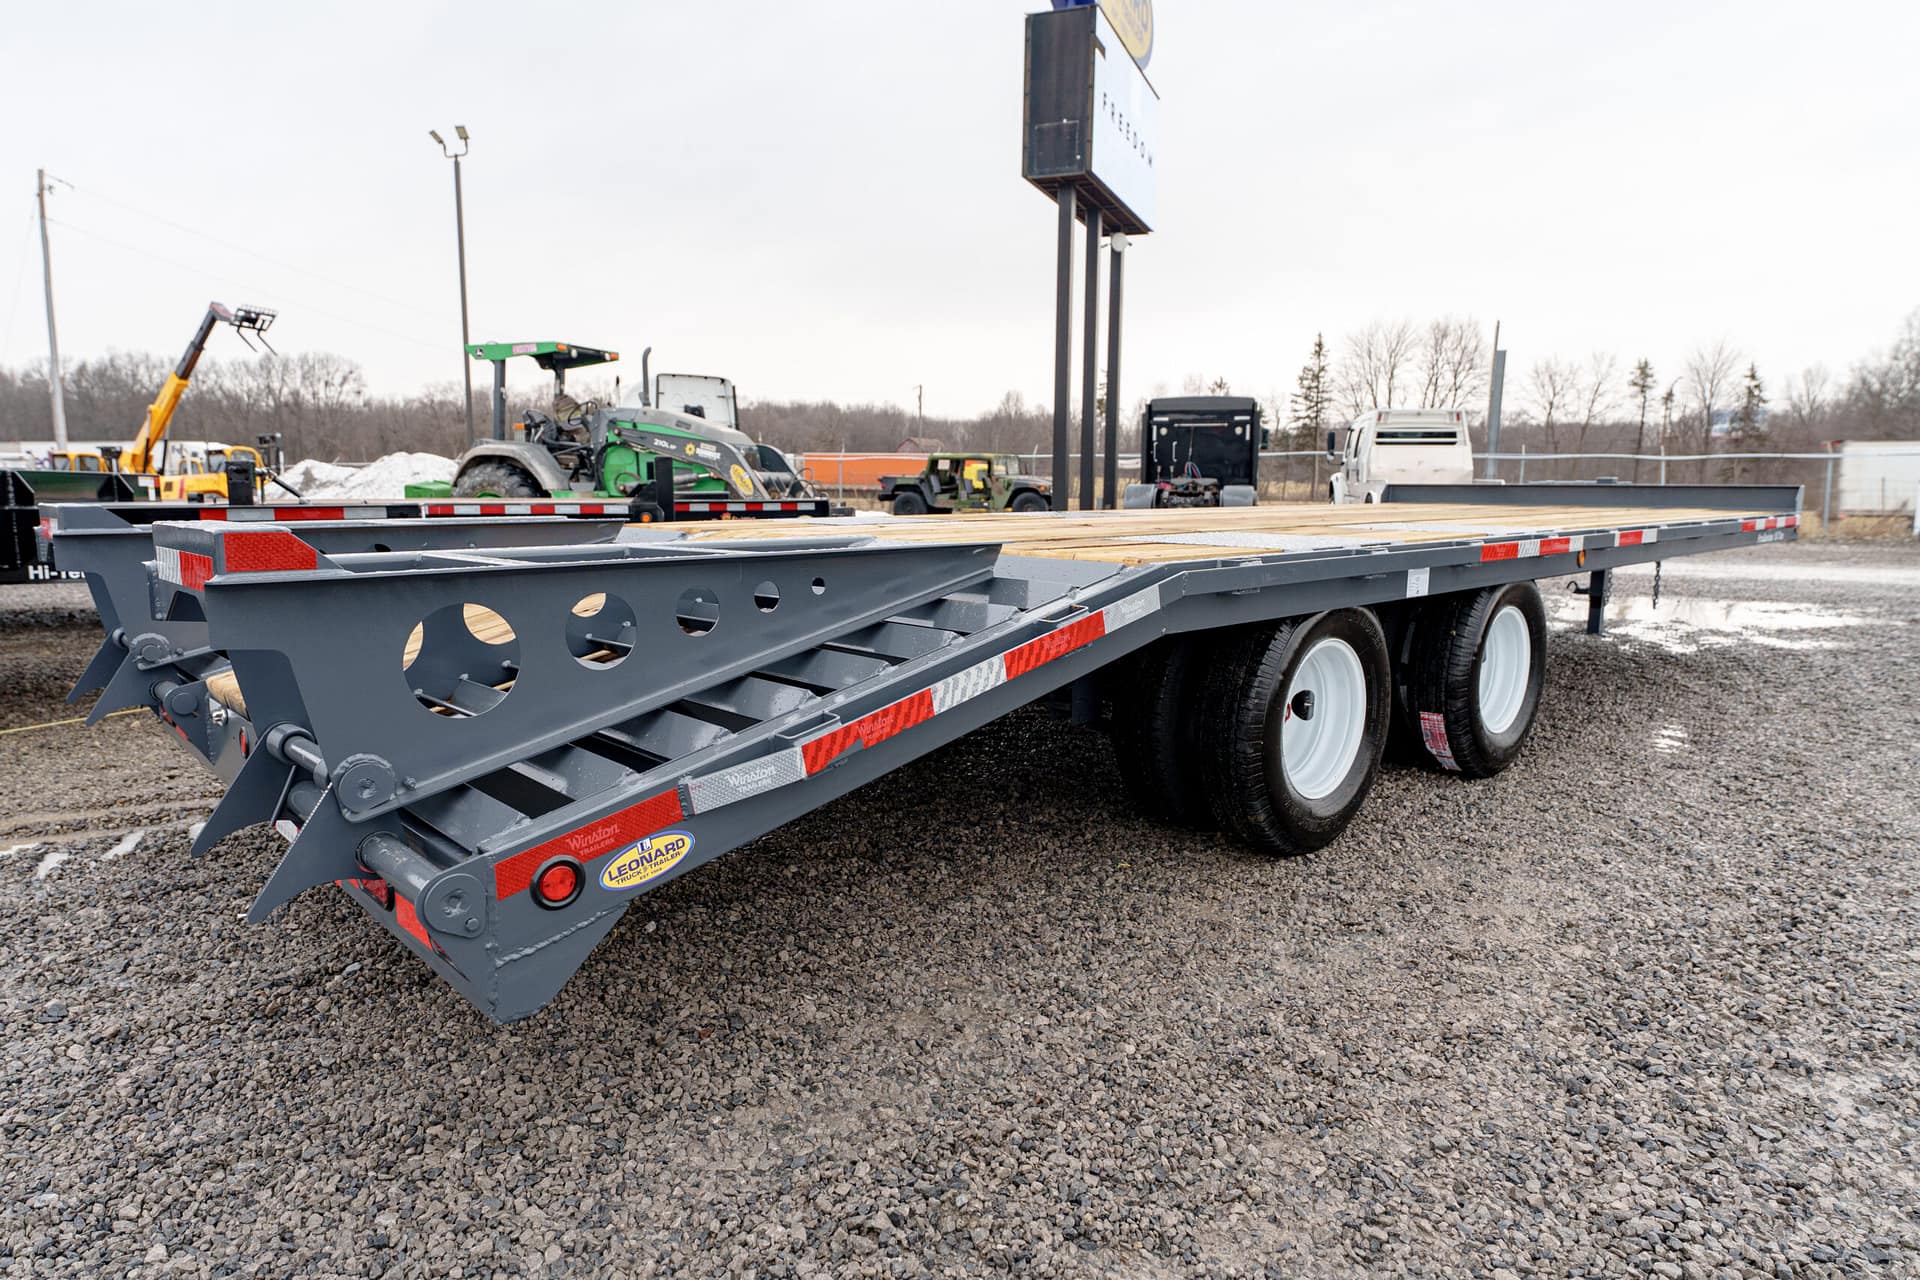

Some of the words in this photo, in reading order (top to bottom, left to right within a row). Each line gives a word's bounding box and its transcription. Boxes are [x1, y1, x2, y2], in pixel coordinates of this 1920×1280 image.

[725, 765, 777, 786] Winston
[566, 822, 620, 850] Winston
[607, 837, 686, 881] LEONARD
[616, 869, 642, 885] TRUCK
[648, 850, 681, 872] TRAILER
